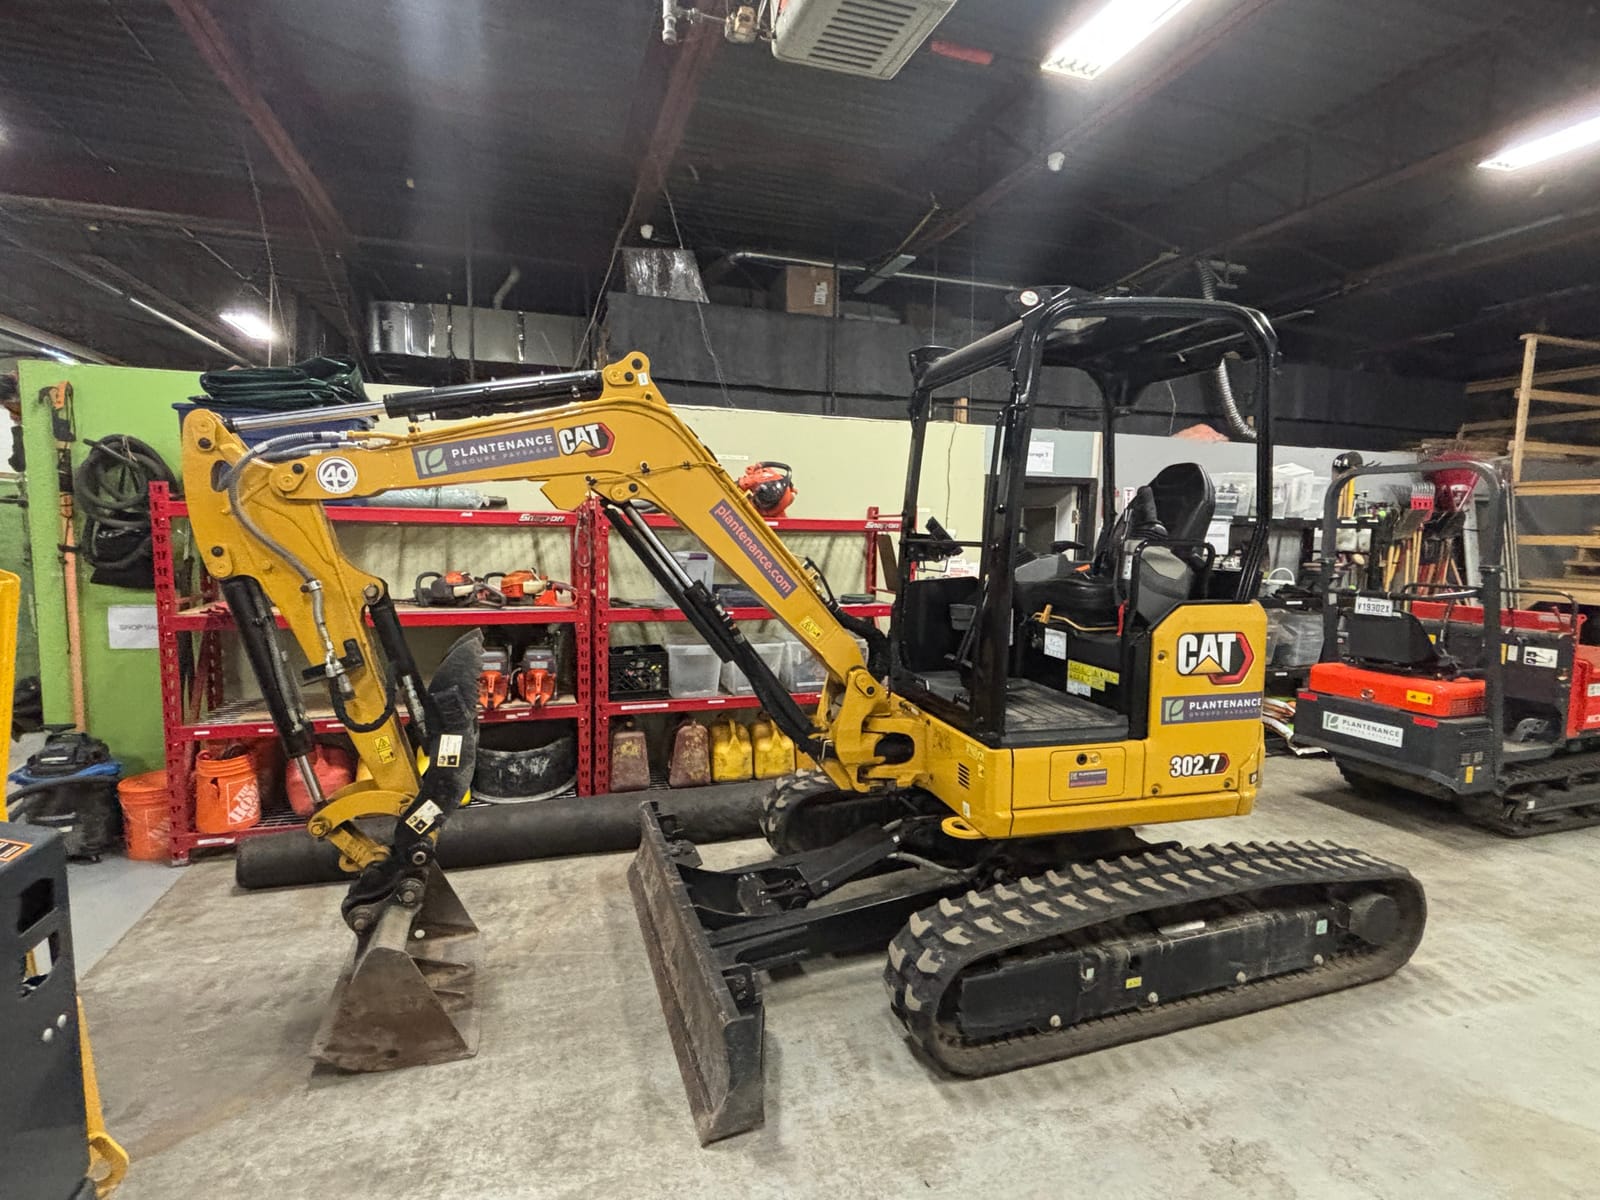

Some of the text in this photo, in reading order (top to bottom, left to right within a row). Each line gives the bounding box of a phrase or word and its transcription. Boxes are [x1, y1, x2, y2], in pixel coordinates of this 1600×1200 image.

[451, 435, 554, 458] PLANTENANCE
[558, 424, 600, 456] CAT
[322, 465, 352, 488] 40
[714, 505, 792, 593] plantenance.com
[1178, 633, 1236, 675] CAT
[1189, 697, 1261, 710] PLANTENANCE
[1342, 719, 1400, 738] PLANTENANCE
[1170, 754, 1220, 777] 302.7
